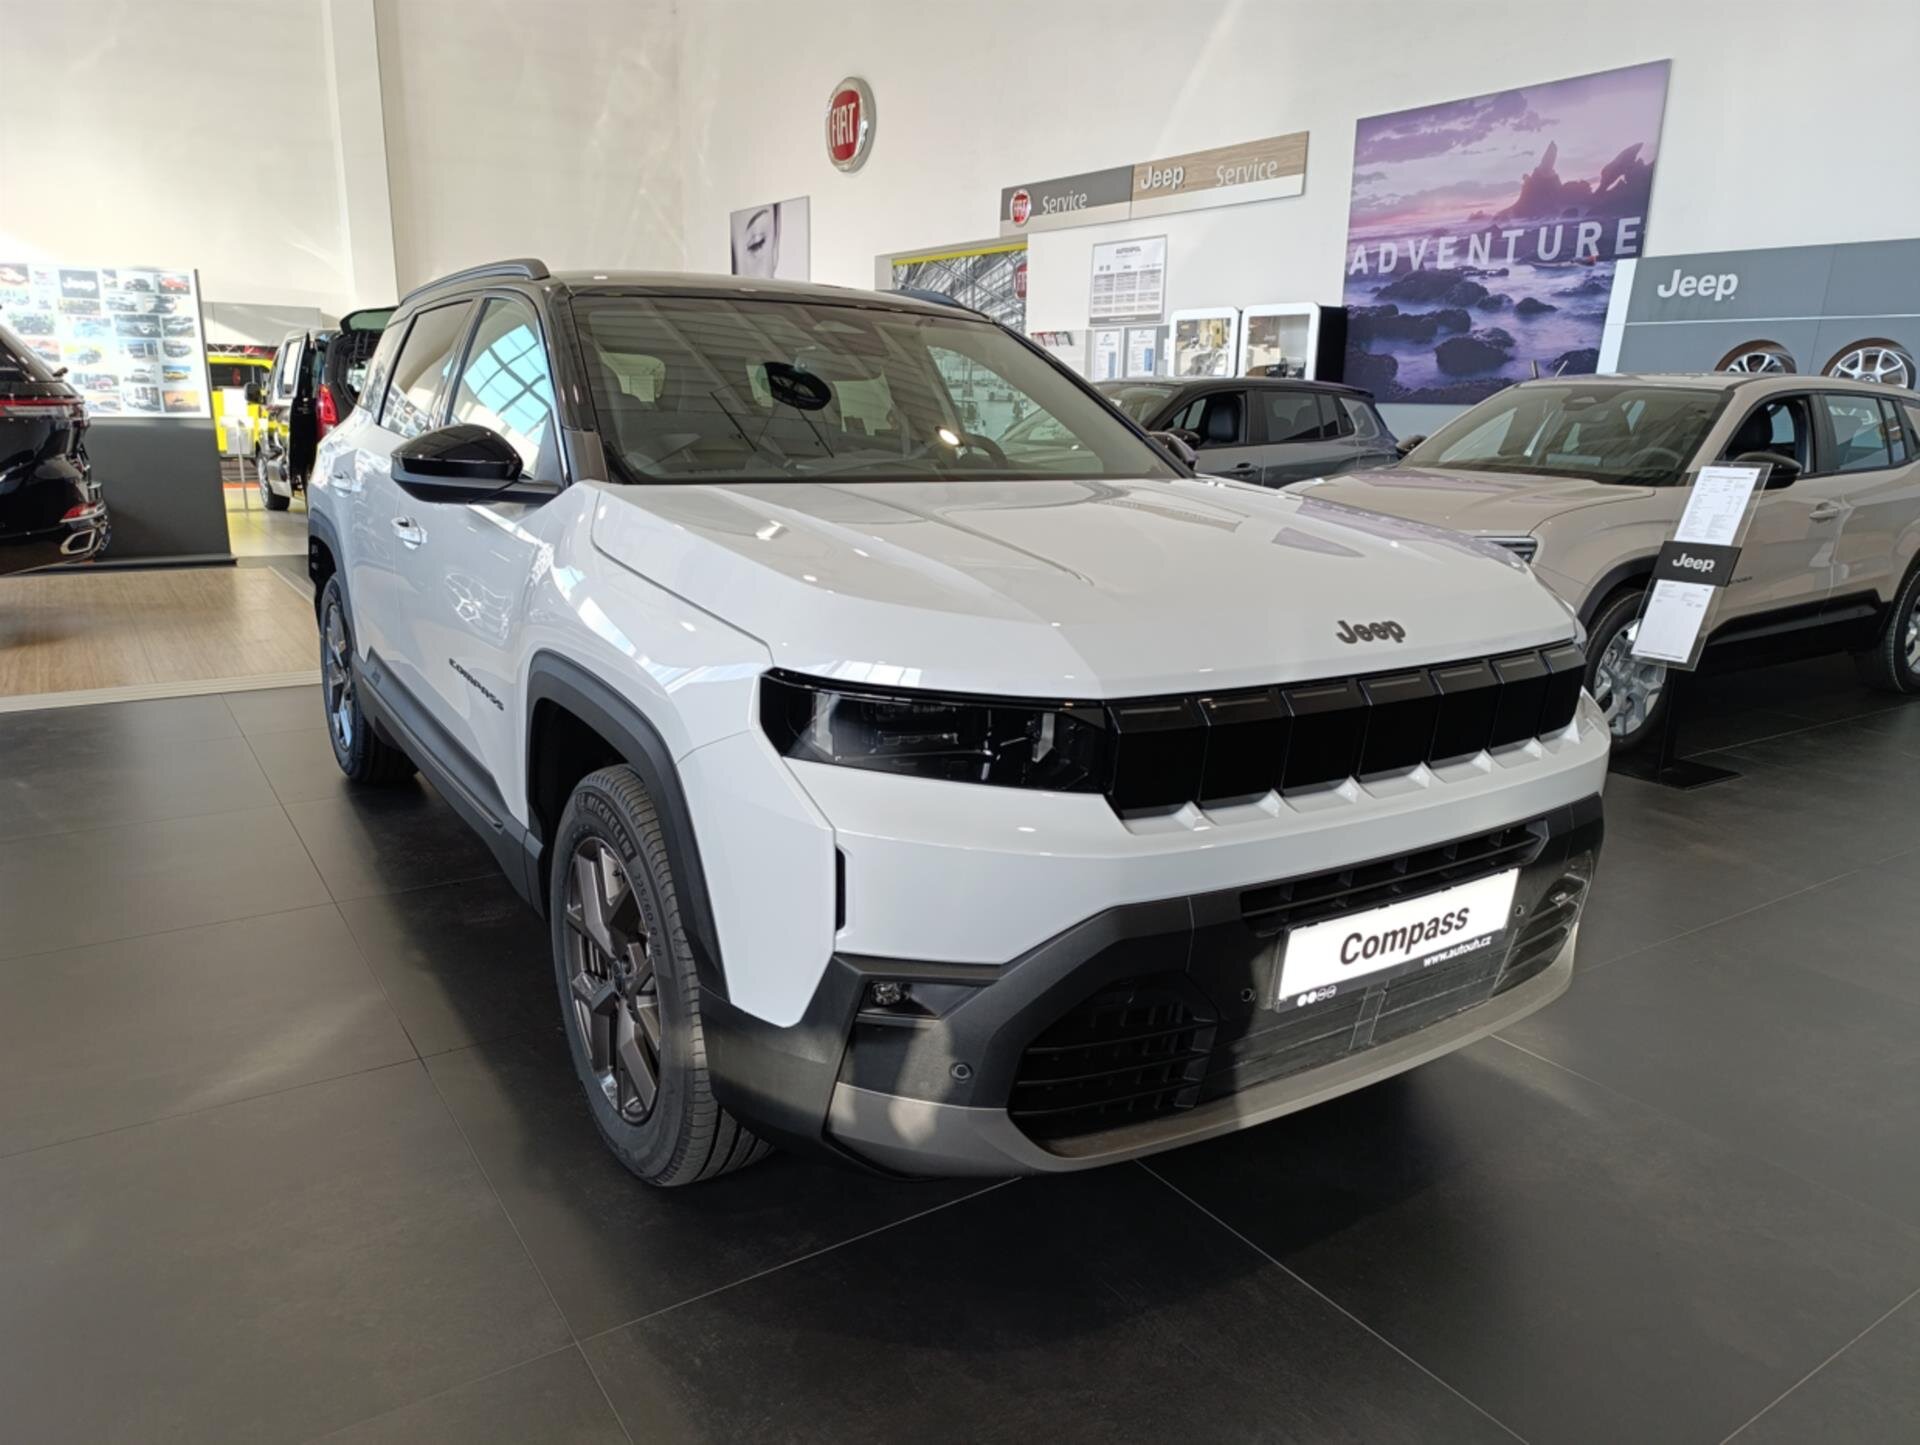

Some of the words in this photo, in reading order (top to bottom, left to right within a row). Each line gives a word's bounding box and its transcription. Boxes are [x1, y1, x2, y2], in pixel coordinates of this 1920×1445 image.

[832, 102, 856, 147] FIAT
[1141, 166, 1184, 190] Jeep
[1216, 158, 1278, 187] Service
[1014, 199, 1027, 216] FIAT
[1042, 191, 1087, 214] Service
[1350, 217, 1642, 275] ADVENTURE
[1657, 269, 1739, 300] Jeep
[1672, 552, 1716, 573] Jeep
[1336, 620, 1406, 644] Jeep
[449, 658, 504, 711] Compass
[586, 794, 634, 857] MICHELIN
[1340, 907, 1469, 965] Compass
[1423, 936, 1493, 968] www.autouh.cz
